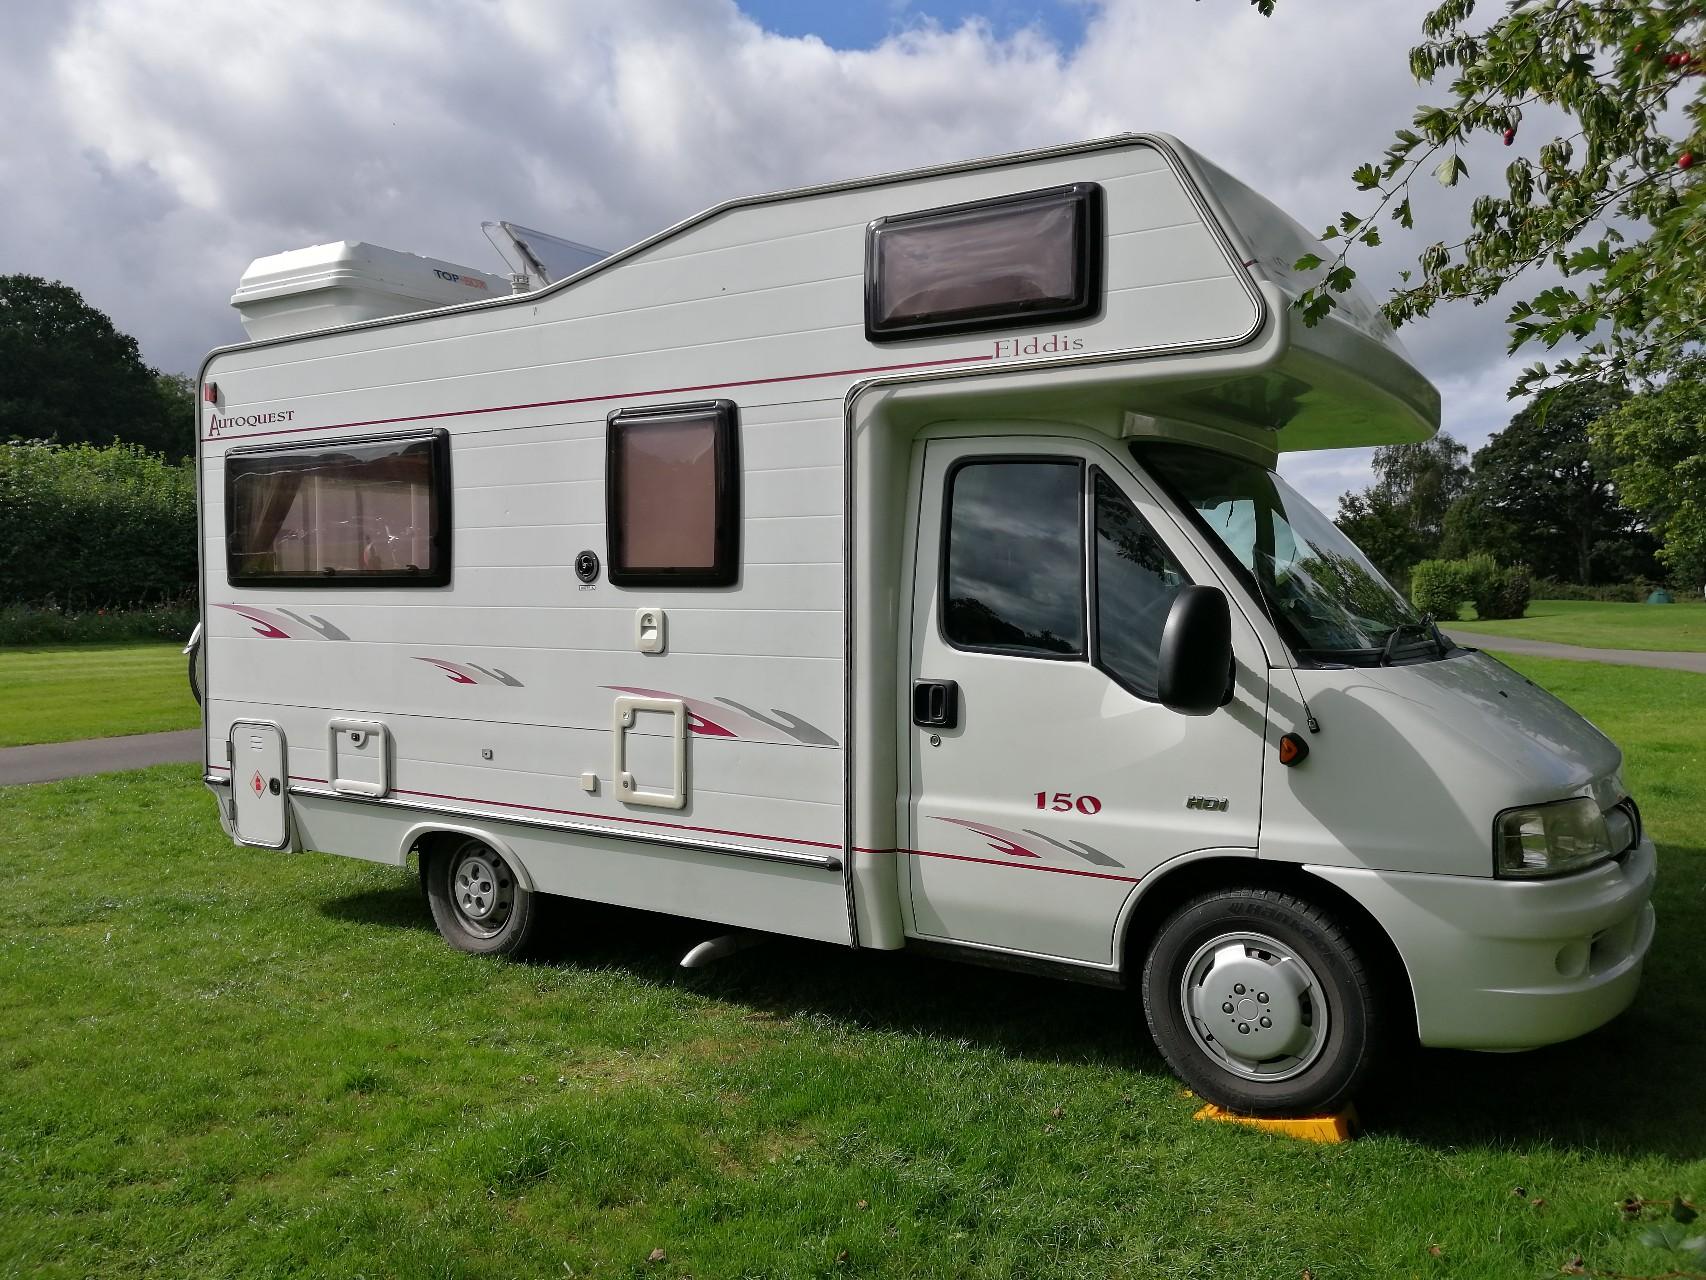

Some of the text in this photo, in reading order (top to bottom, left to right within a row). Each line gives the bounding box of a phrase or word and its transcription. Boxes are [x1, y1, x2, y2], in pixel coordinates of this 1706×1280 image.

[433, 269, 459, 282] TOP
[994, 334, 1084, 359] Elddis
[1034, 791, 1102, 815] 150
